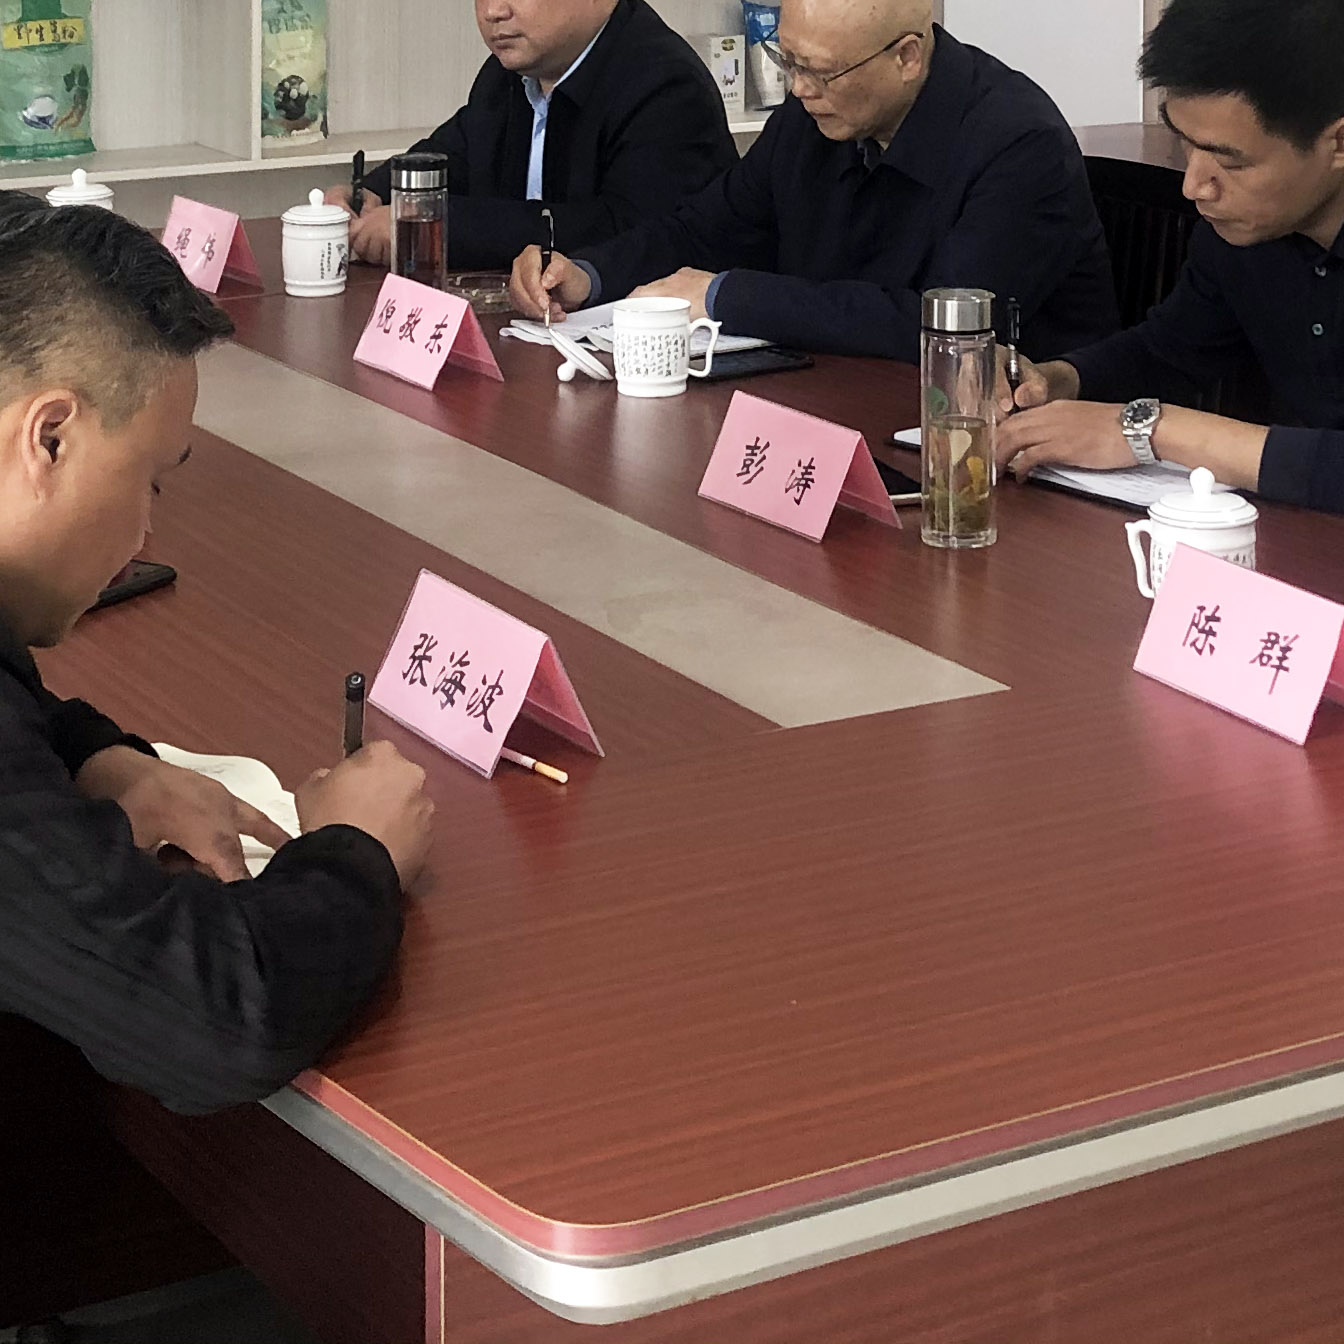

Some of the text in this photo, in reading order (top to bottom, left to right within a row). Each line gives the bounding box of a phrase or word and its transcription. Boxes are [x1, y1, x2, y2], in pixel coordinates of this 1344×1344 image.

[376, 298, 449, 354] 倪敬东
[736, 436, 816, 506] 彭涛
[401, 632, 505, 734] 张海波
[1181, 604, 1301, 696] 陈群
